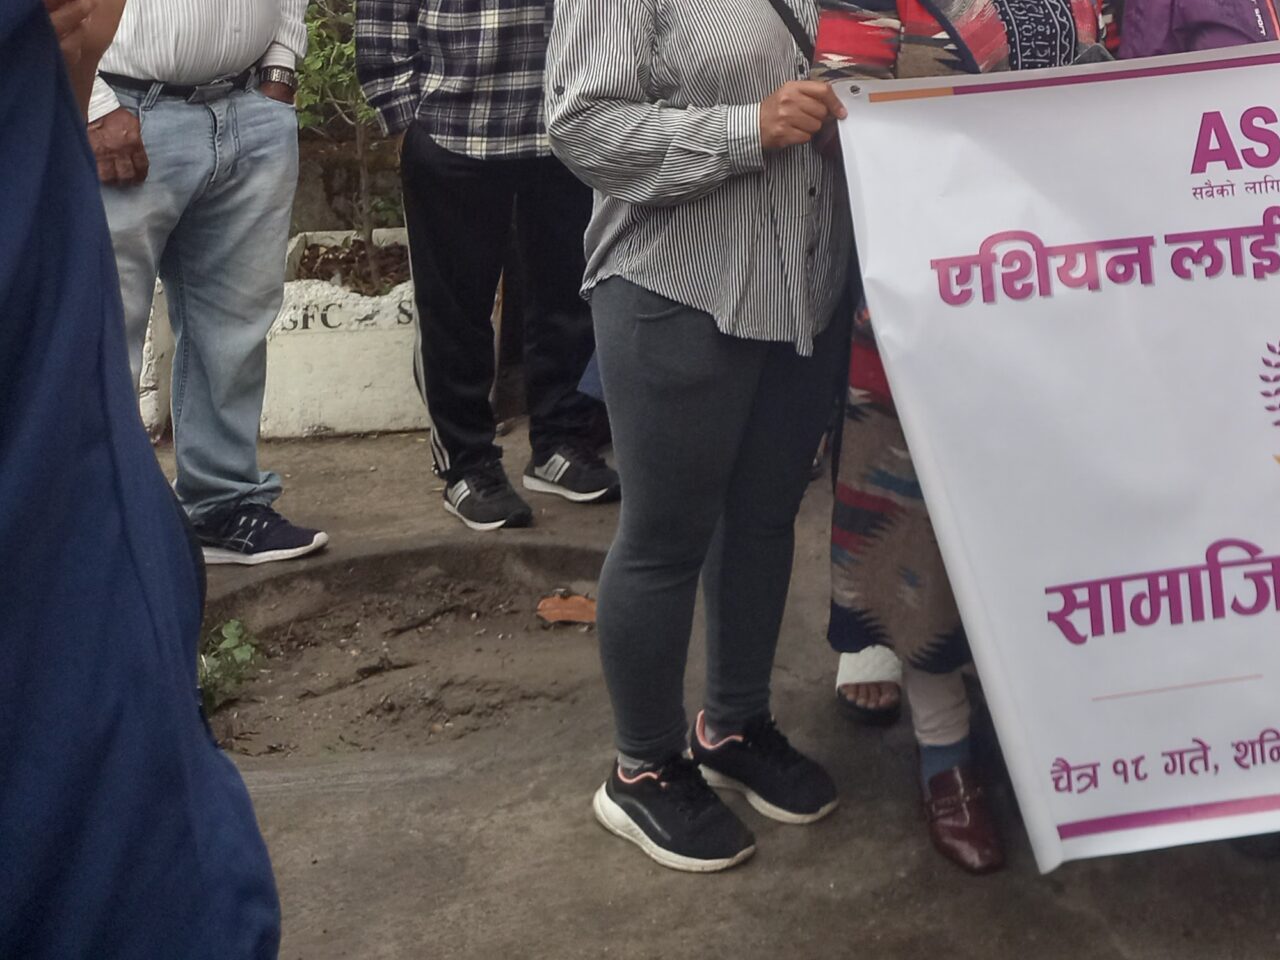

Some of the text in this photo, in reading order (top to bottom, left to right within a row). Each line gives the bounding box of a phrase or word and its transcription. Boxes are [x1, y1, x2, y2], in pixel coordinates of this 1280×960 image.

[1244, 174, 1280, 195] लागि
[931, 230, 1156, 307] एशियन
[1050, 757, 1101, 795] चैत्र
[1112, 755, 1149, 785] १८
[1161, 737, 1220, 776] गते,
